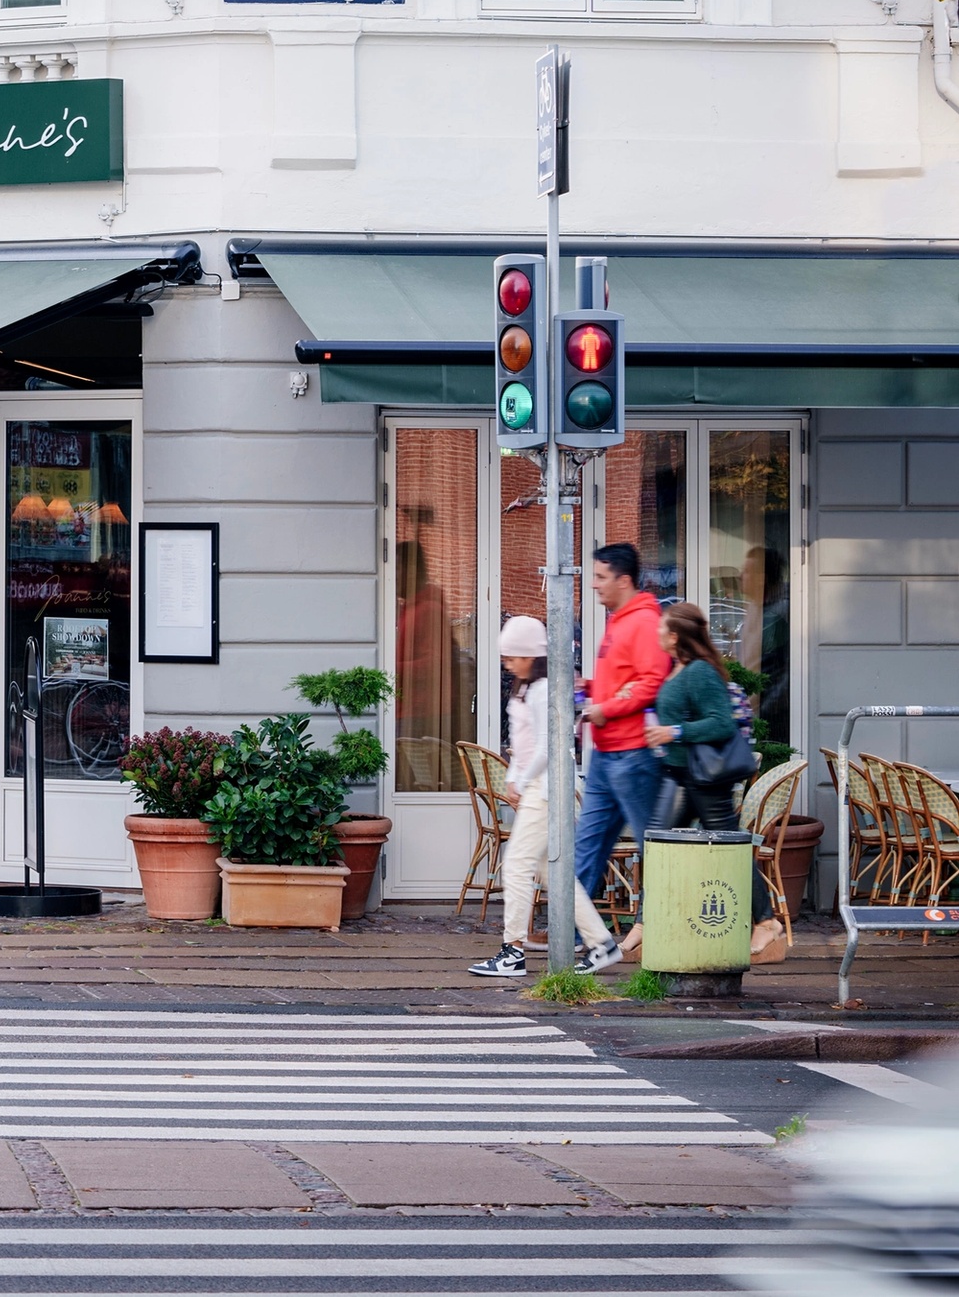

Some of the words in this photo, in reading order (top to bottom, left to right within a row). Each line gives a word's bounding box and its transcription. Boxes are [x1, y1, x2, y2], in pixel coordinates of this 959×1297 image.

[34, 574, 111, 622] Joanne's
[51, 633, 101, 642] SHOWDOWN
[57, 624, 97, 633] ROOFTOP
[700, 879, 739, 906] KOMMUNE
[687, 911, 739, 939] KØBENHAVNS
